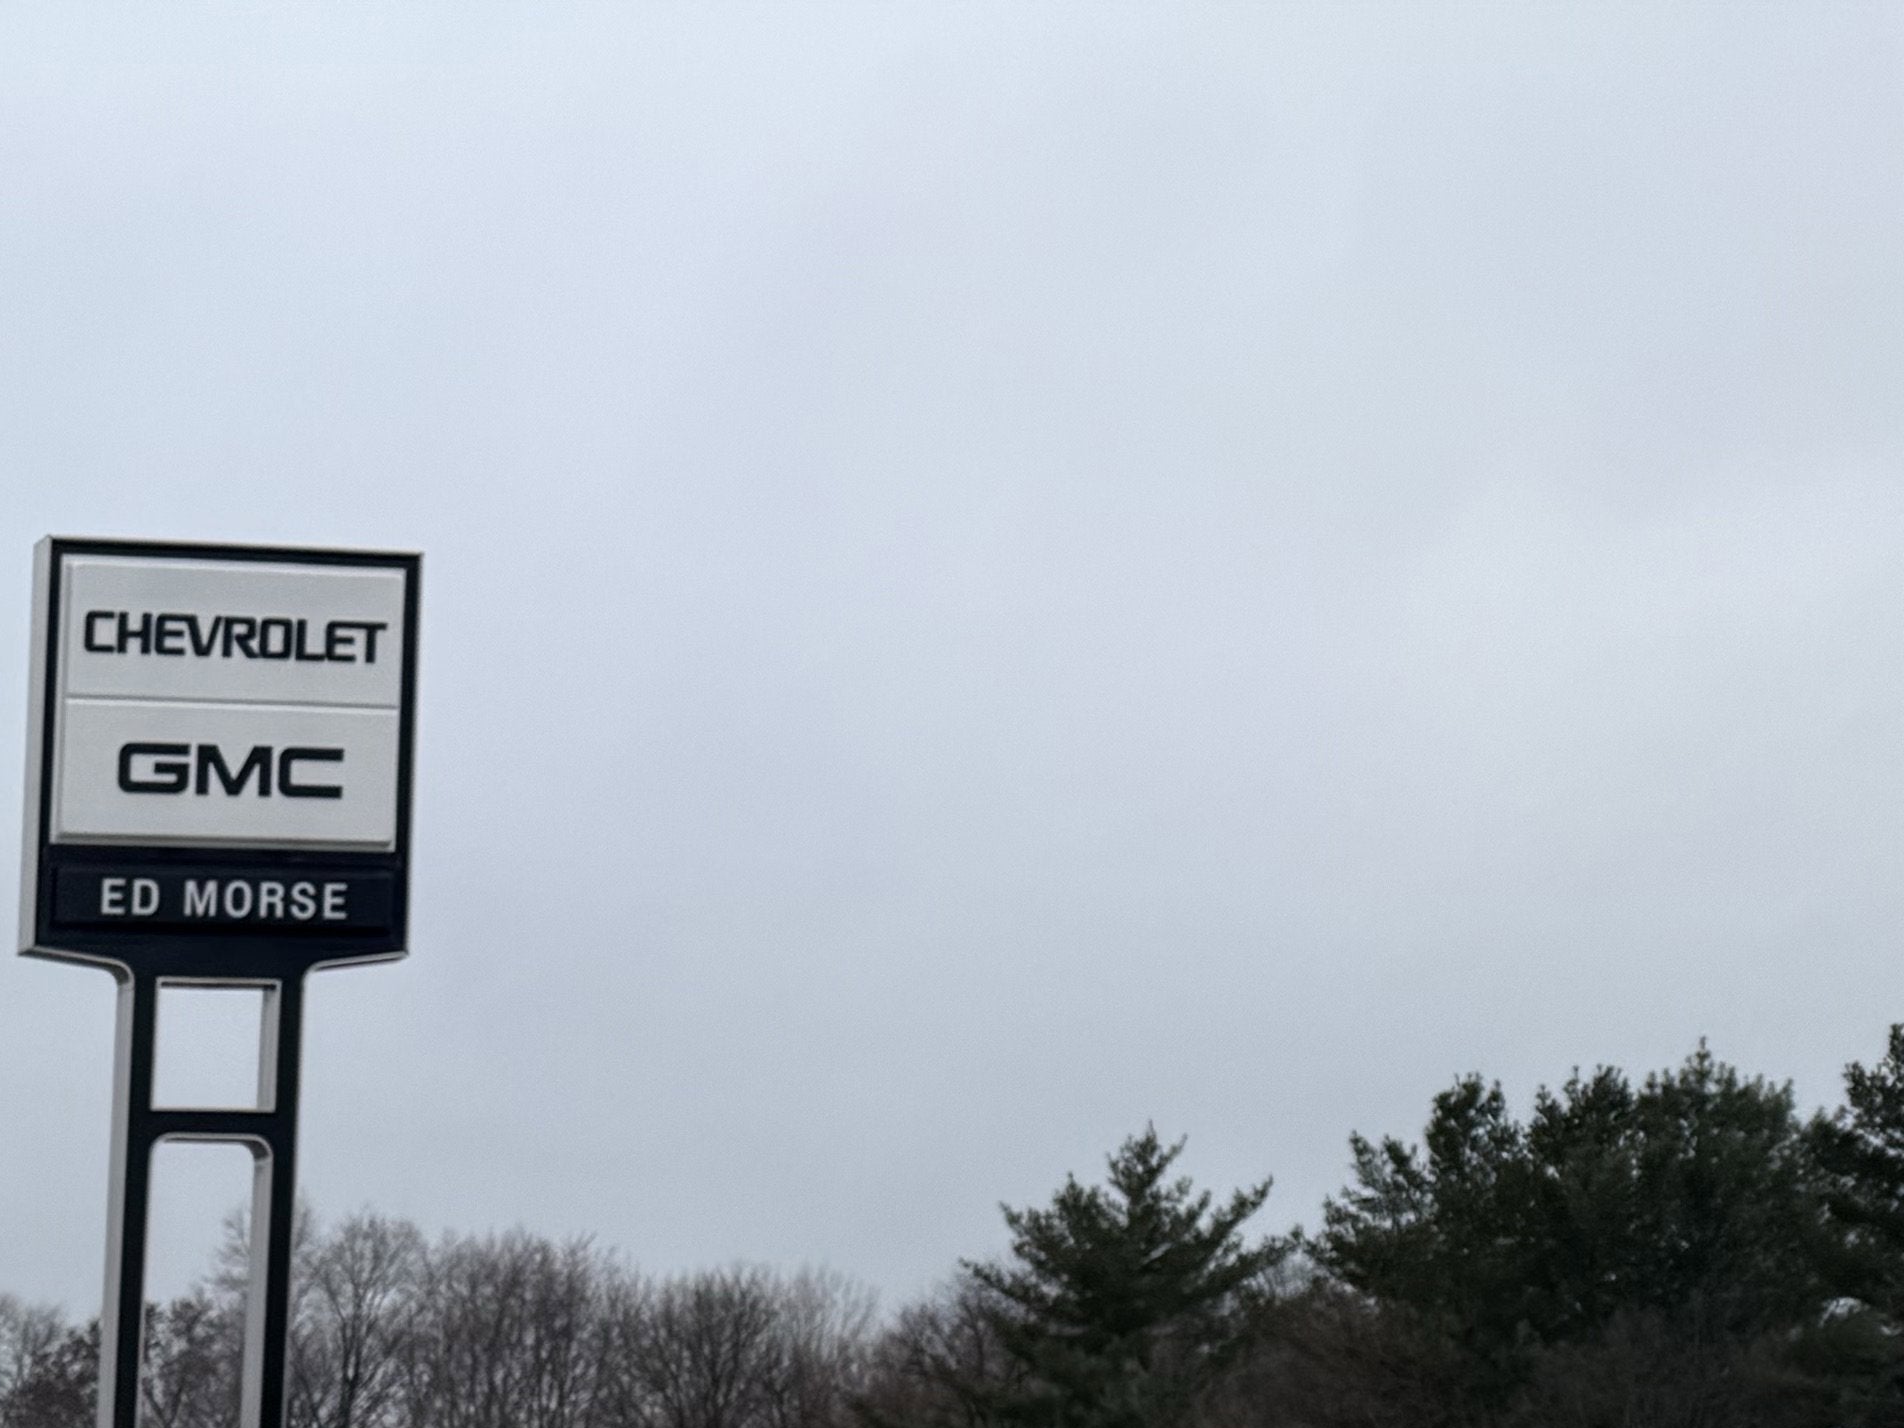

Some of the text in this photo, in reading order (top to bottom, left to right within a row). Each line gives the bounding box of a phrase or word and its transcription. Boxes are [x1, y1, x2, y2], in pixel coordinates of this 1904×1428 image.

[84, 611, 388, 663] CHEVROLET
[117, 742, 345, 799] GMC
[100, 878, 348, 920] ED MORSE
